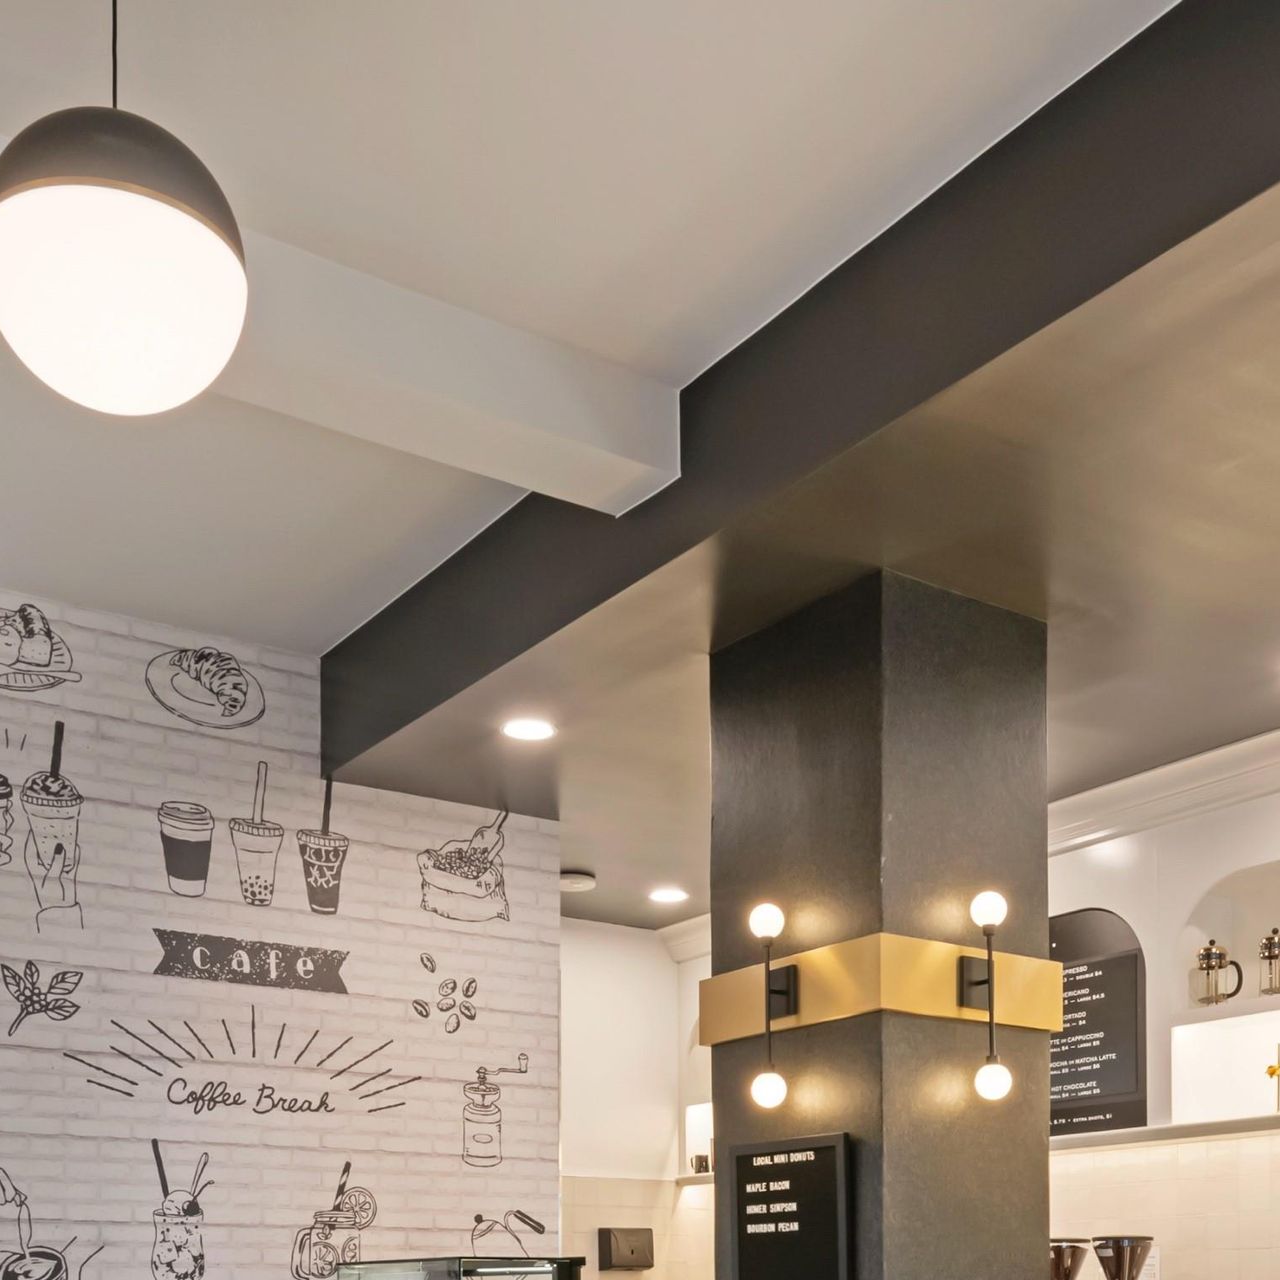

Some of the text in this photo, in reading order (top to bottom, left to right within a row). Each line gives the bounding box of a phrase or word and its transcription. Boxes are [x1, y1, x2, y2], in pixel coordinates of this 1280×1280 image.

[1063, 965, 1088, 975] PRESSO
[1063, 988, 1090, 998] ERICANO
[1063, 1011, 1087, 1020] ORTADO
[1067, 1031, 1105, 1043] CAPPUCCINO
[1098, 1053, 1117, 1061] LATTE
[1063, 1081, 1097, 1091] CHOCOLATE
[167, 1078, 336, 1115] Coffee Break
[753, 1150, 815, 1166] LOCAL MINI DONUTS
[746, 1180, 790, 1193] MAPLE BACON
[746, 1202, 797, 1214] HOMER SIMPSON
[746, 1221, 799, 1234] BOURBON PECAN
